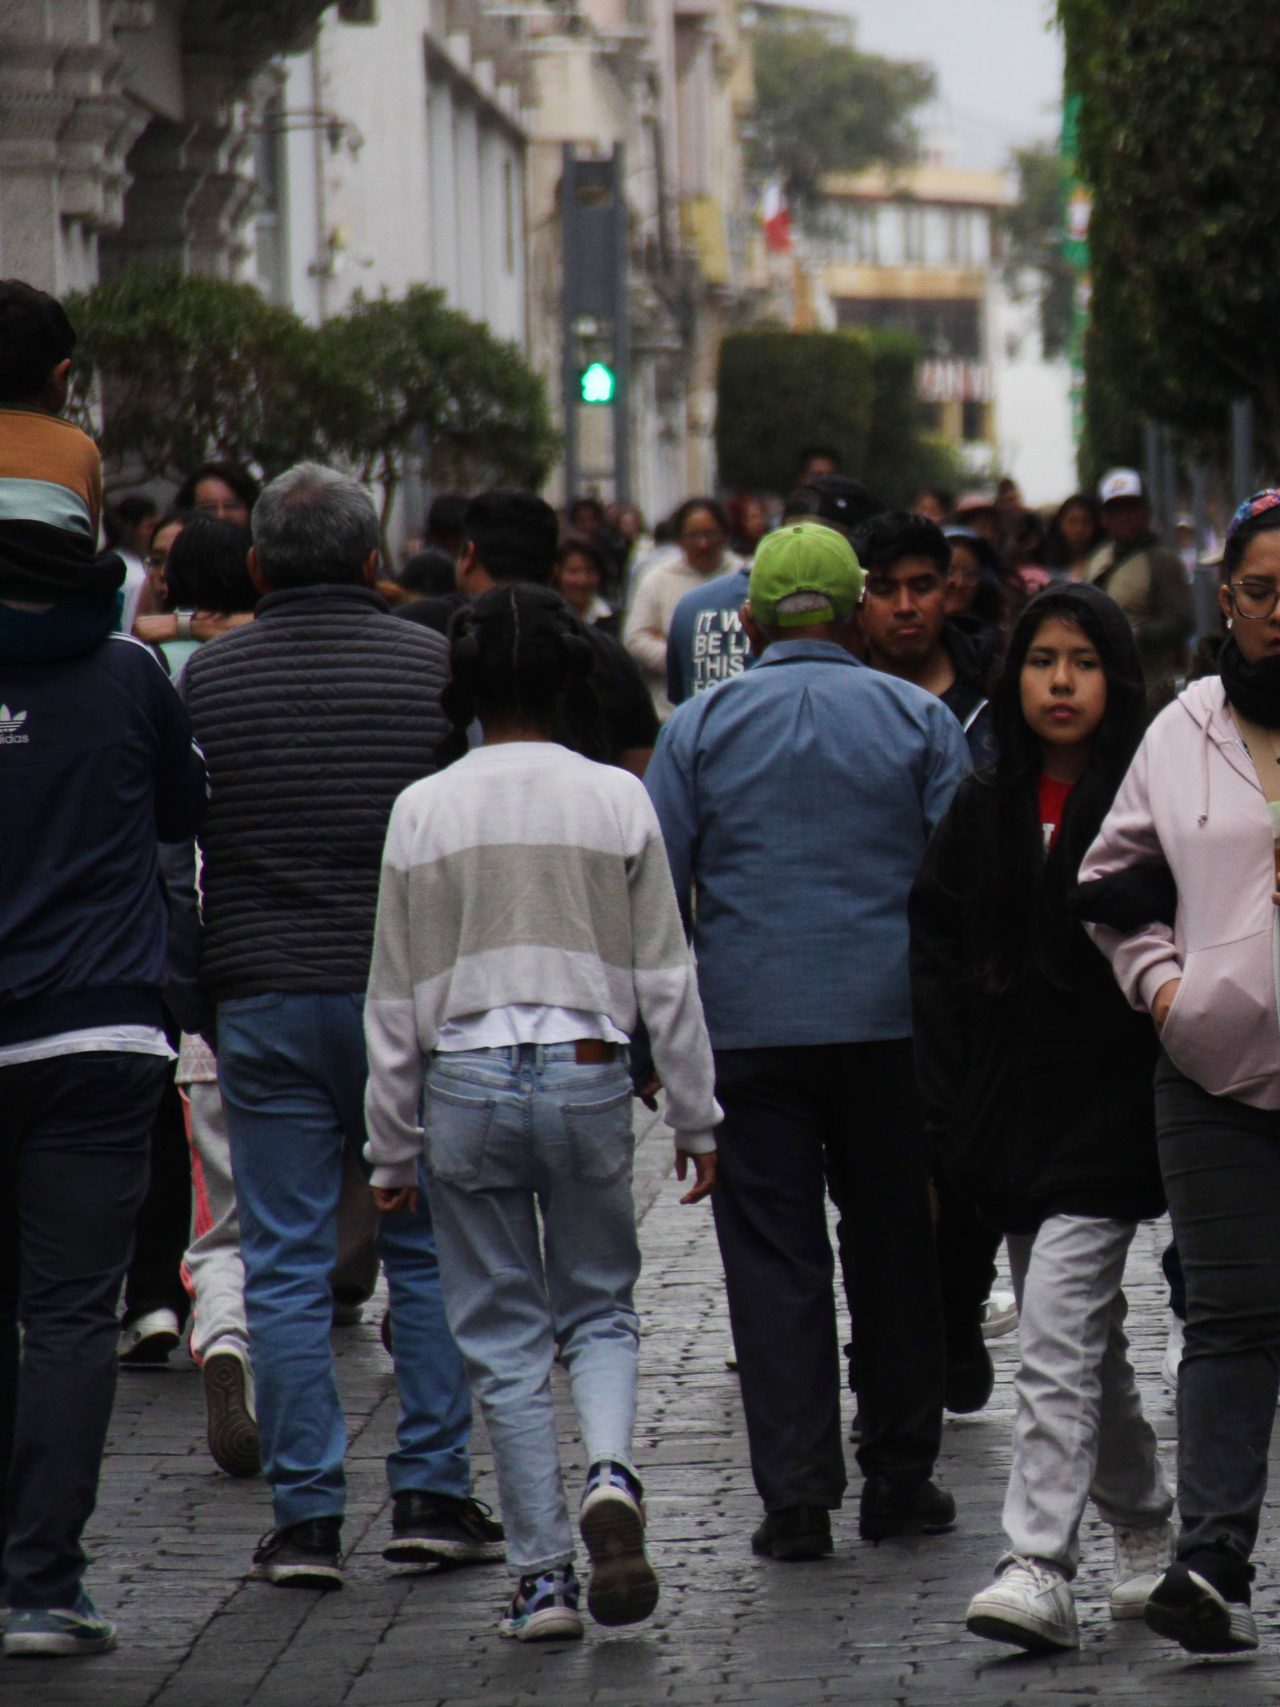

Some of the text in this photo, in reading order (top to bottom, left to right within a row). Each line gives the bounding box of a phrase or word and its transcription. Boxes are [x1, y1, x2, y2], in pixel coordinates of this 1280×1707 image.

[696, 611, 718, 633] IT
[695, 633, 723, 656] BE
[694, 655, 745, 679] THIS
[0, 733, 30, 745] idas
